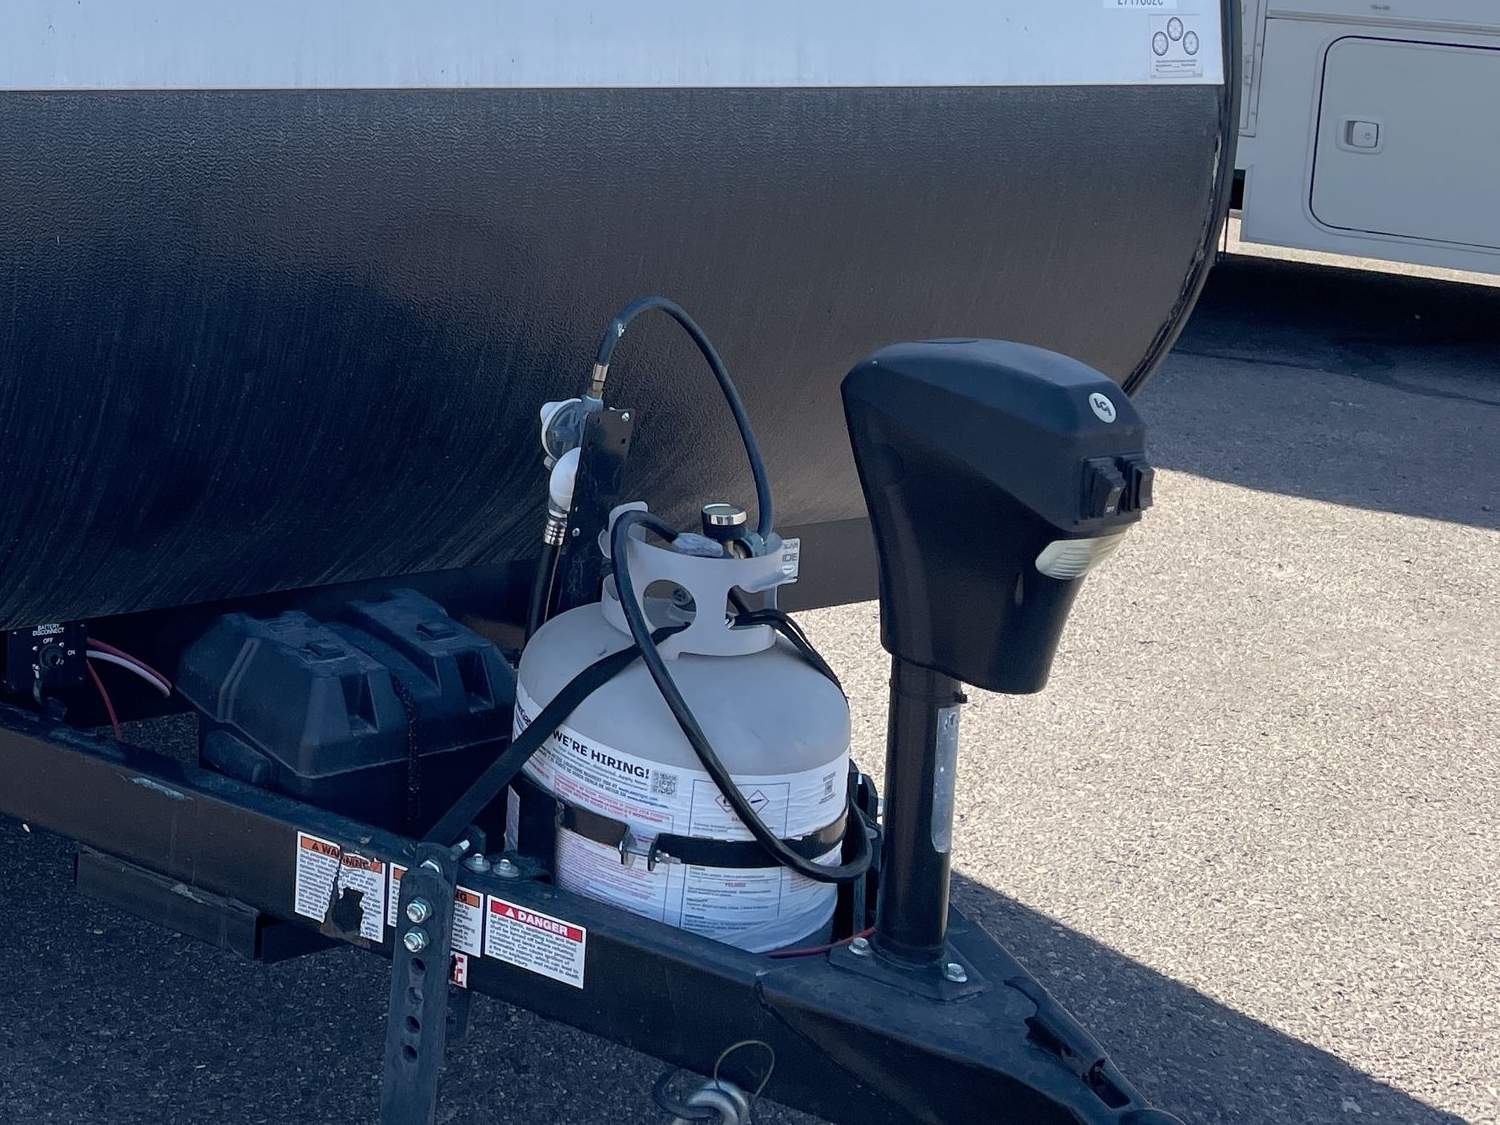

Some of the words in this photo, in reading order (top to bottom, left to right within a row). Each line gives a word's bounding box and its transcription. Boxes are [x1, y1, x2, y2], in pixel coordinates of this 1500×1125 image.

[553, 730, 588, 757] WE'RE
[591, 749, 650, 780] HIRING!
[517, 910, 568, 936] DANGER
